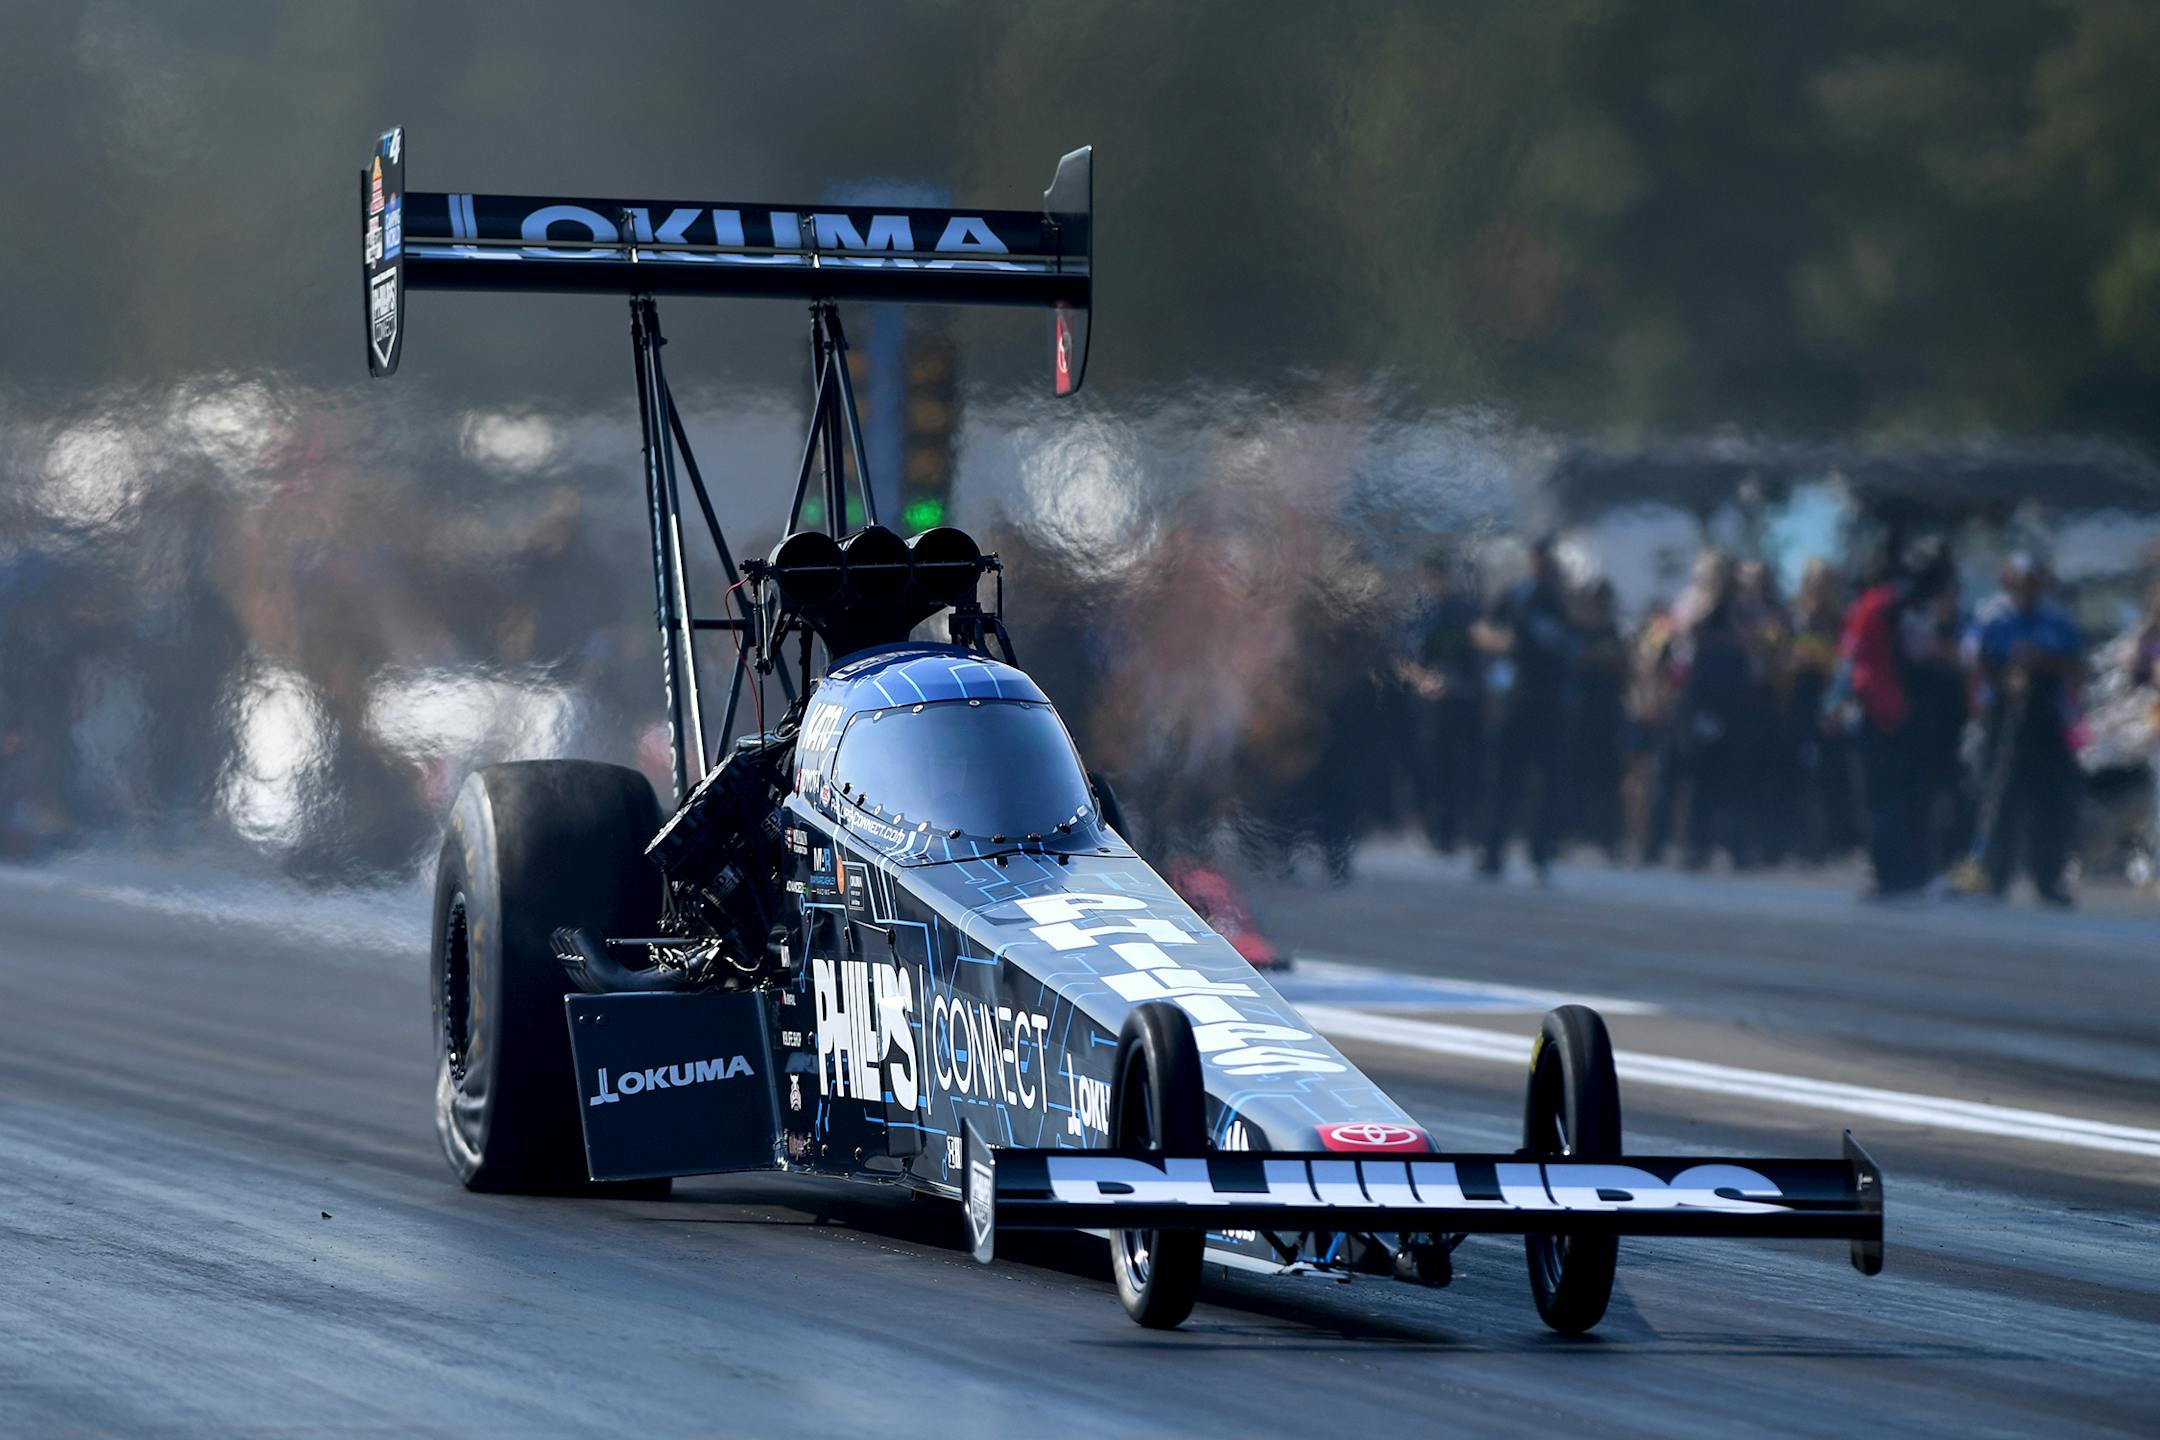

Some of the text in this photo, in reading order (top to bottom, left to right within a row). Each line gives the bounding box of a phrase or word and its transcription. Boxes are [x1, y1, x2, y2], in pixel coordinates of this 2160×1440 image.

[812, 958, 1049, 1113] PHILLIPS CONNECT
[1014, 893, 1347, 1075] PHILLIPS
[617, 1054, 755, 1096] OKUMA
[1046, 1156, 1795, 1214] PHILLIPS
